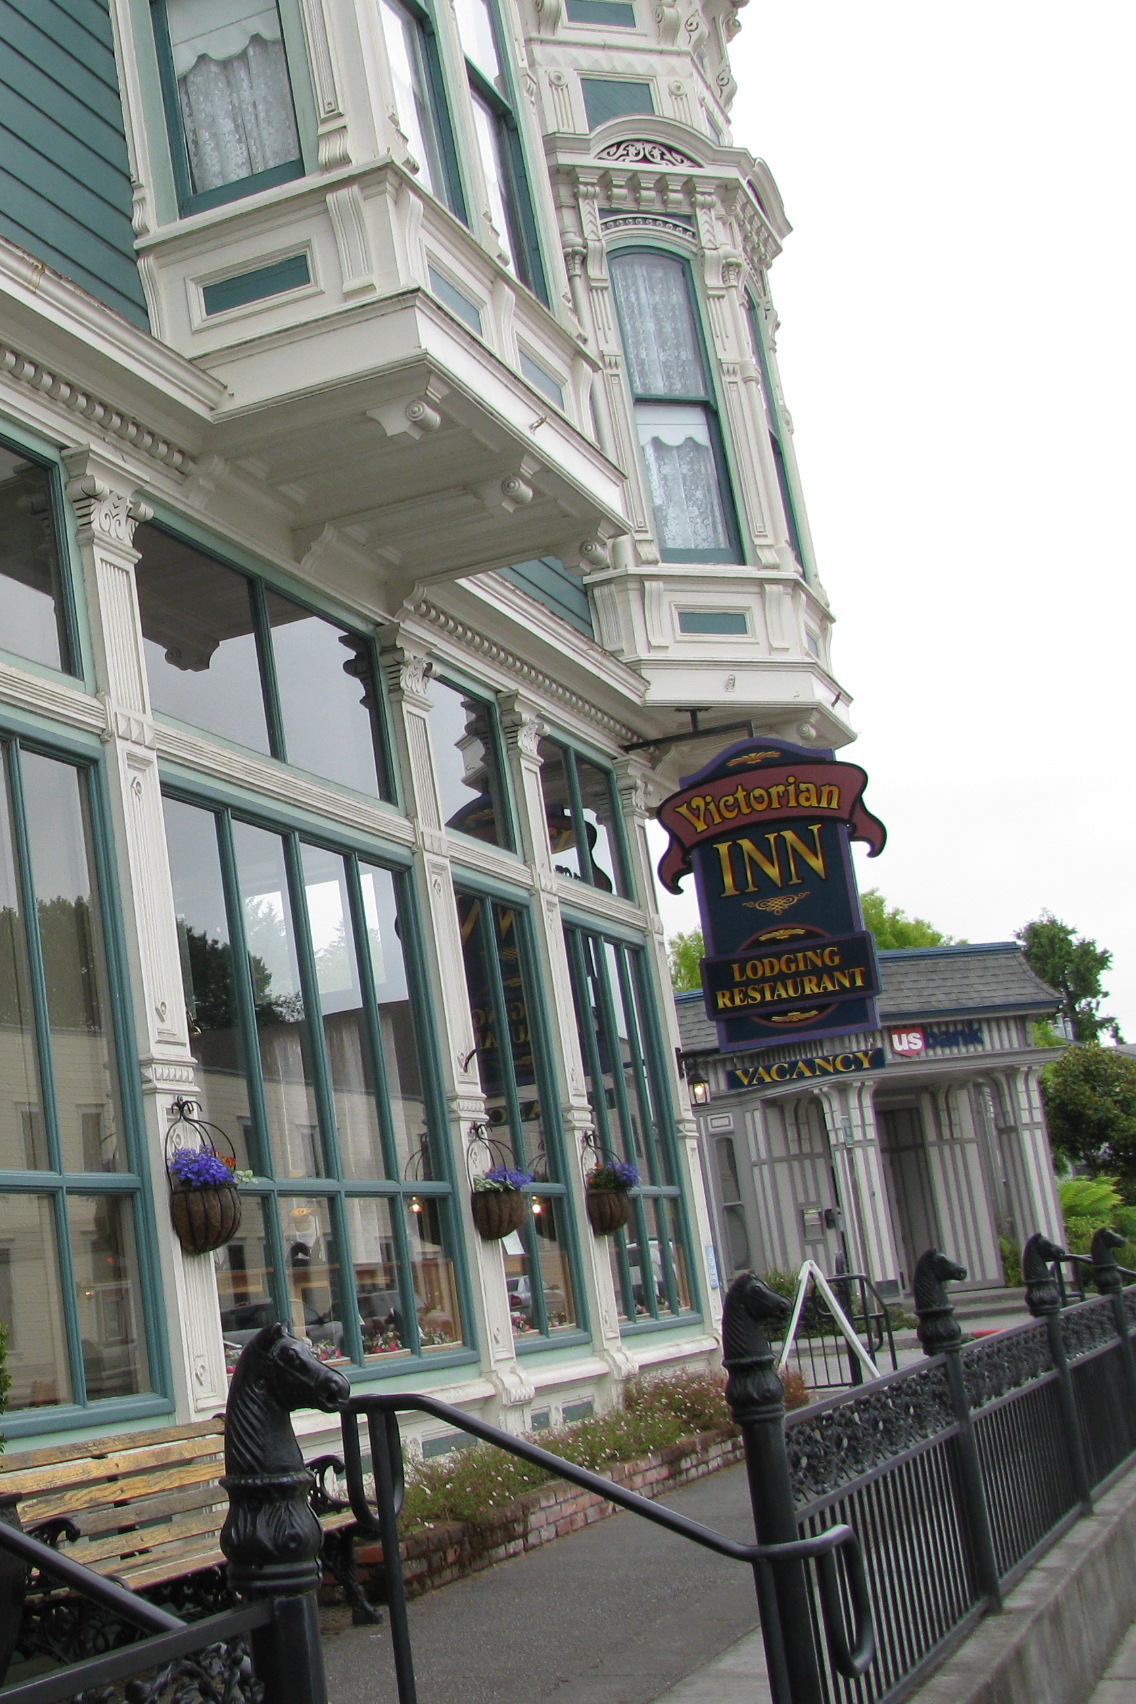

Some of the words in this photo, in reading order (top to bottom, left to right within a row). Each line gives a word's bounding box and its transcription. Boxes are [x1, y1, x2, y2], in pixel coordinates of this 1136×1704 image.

[675, 776, 840, 833] Victorian
[713, 824, 828, 897] INN
[732, 947, 841, 982] LODGING
[716, 967, 865, 1009] RESTAURANT
[925, 1019, 984, 1049] bank
[735, 1051, 874, 1086] VACANCY
